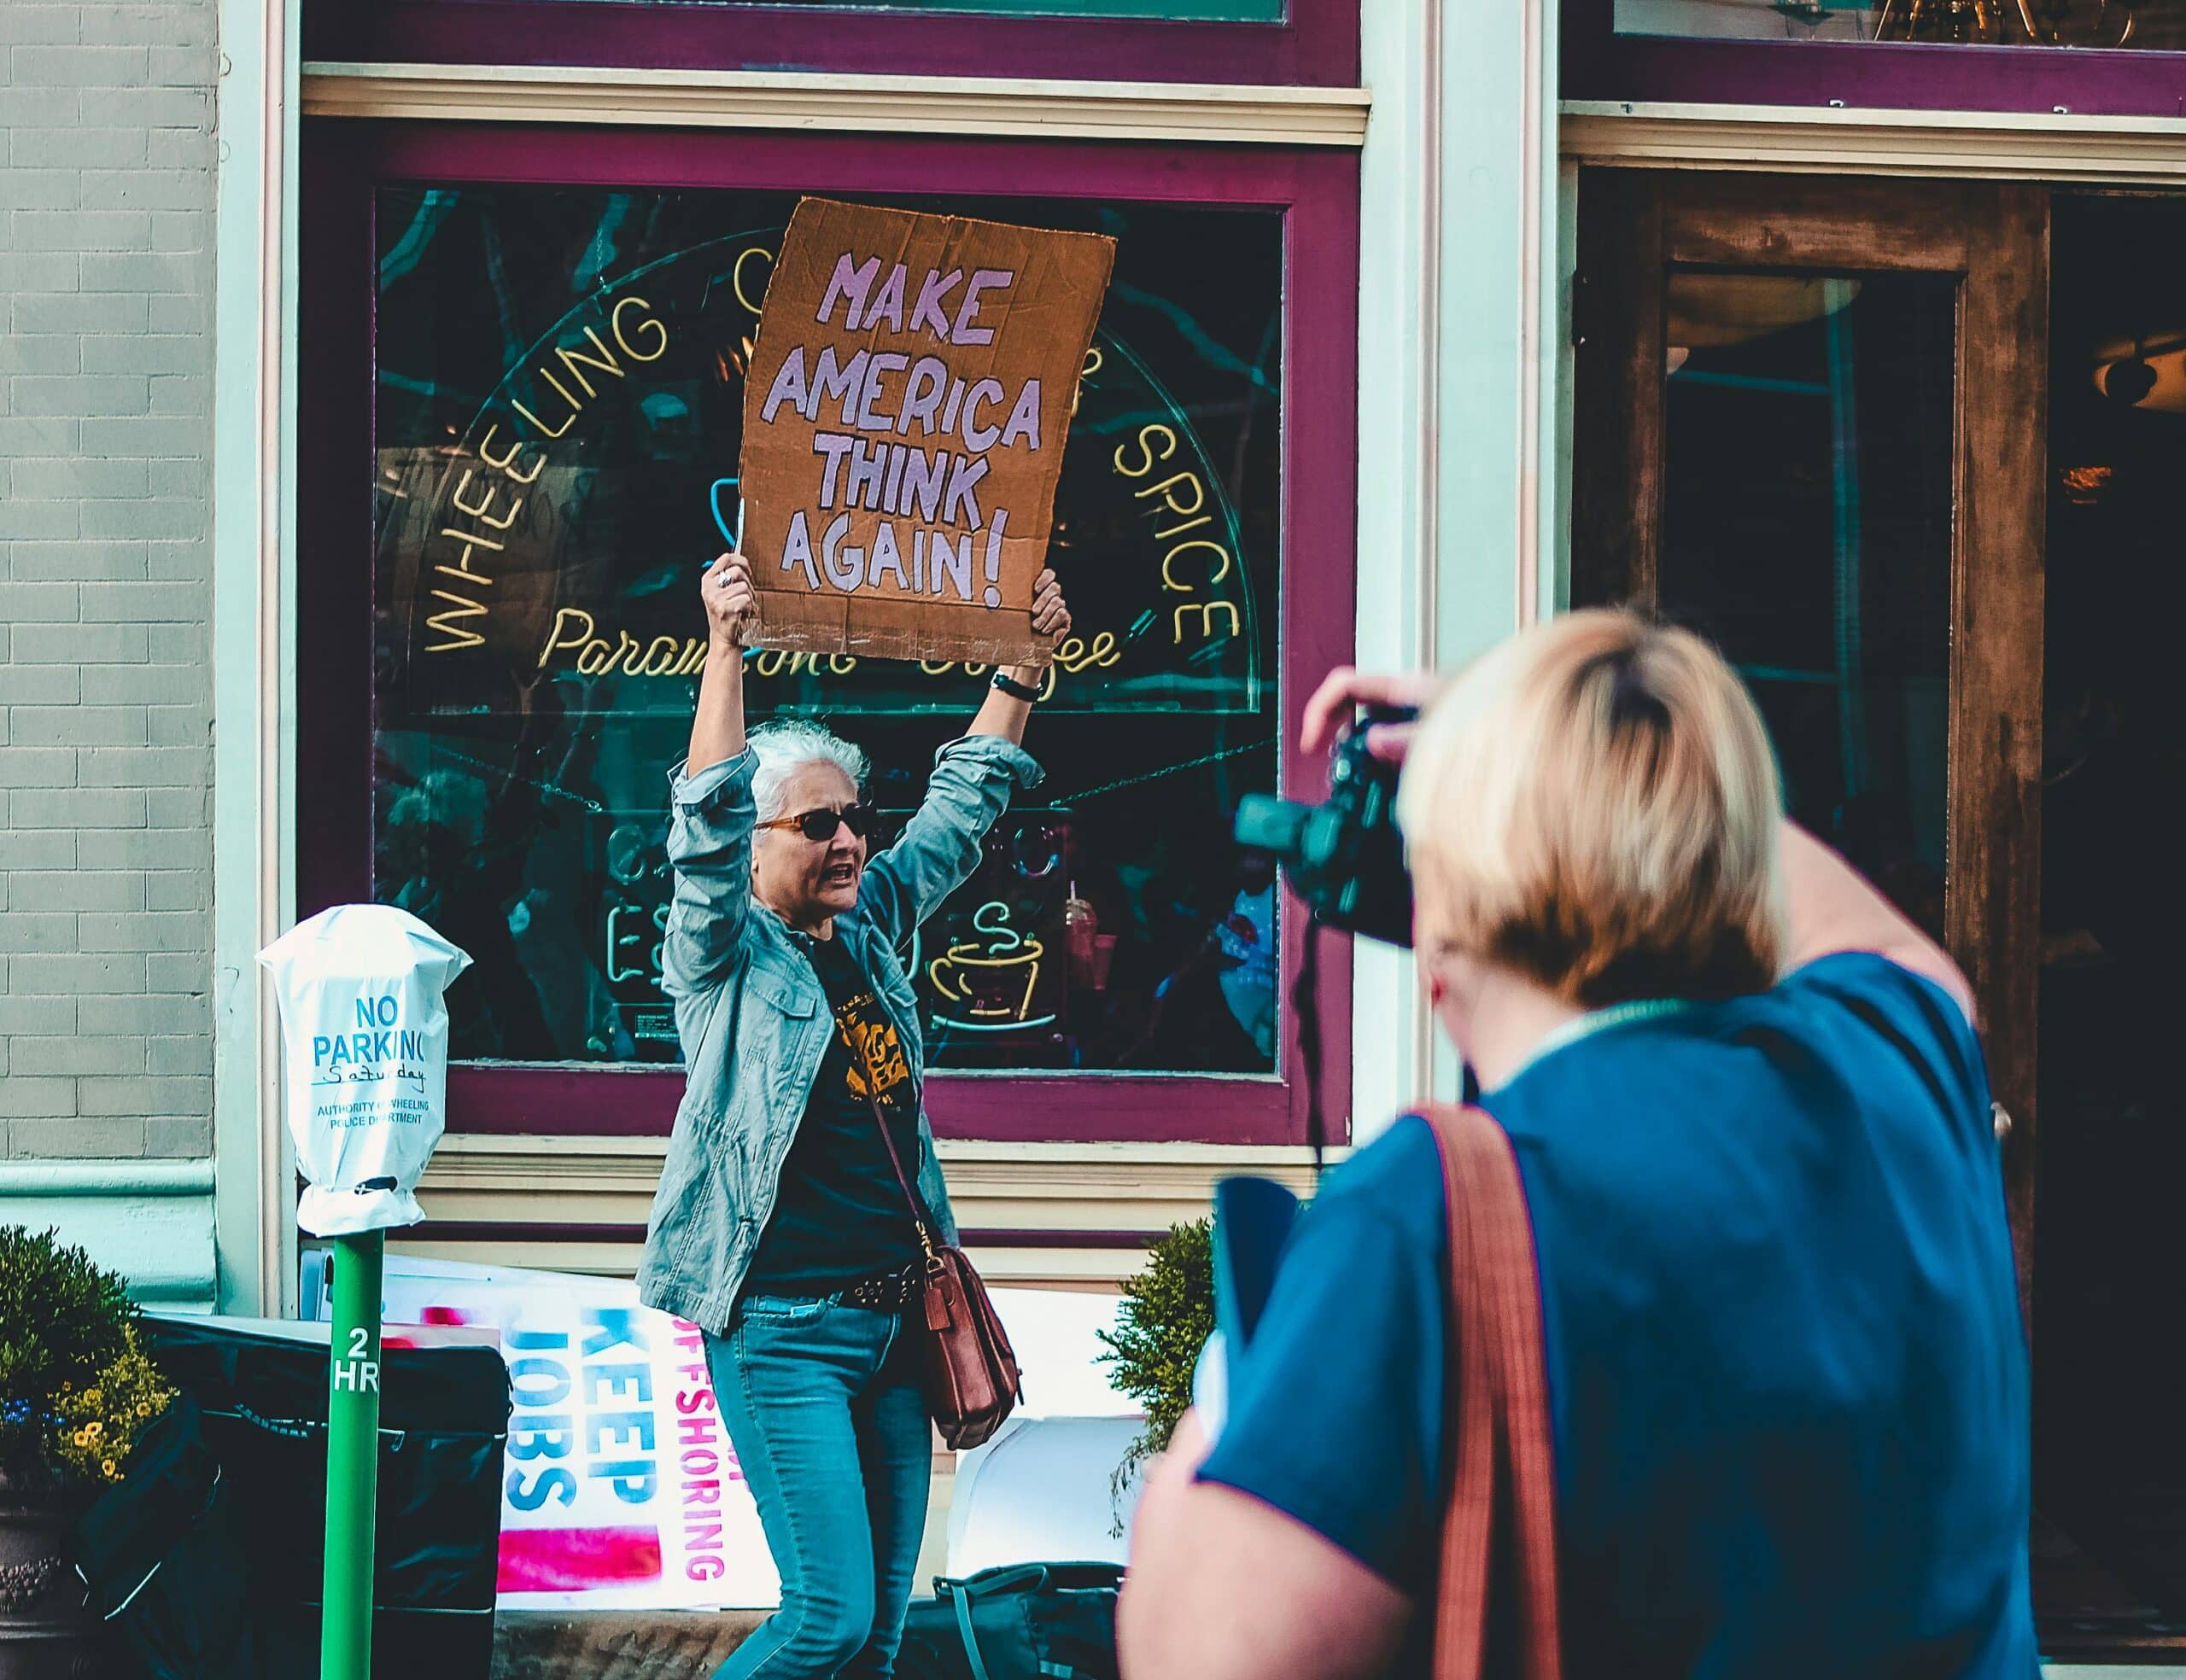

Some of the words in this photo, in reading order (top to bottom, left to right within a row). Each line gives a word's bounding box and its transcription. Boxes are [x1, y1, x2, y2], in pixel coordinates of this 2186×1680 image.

[816, 252, 1015, 345] MAKE
[761, 346, 1041, 453] AMERICA
[424, 296, 669, 651] WHEELING
[1113, 423, 1241, 645] SPICE
[813, 431, 991, 532] THINK
[780, 508, 1009, 609] AGAIN!
[356, 995, 398, 1028] NO
[318, 1101, 375, 1117] AUTHORITY
[334, 1359, 378, 1393] HR
[348, 1327, 368, 1358] 2
[501, 1305, 577, 1511] JOBS
[580, 1308, 658, 1504] KEEP
